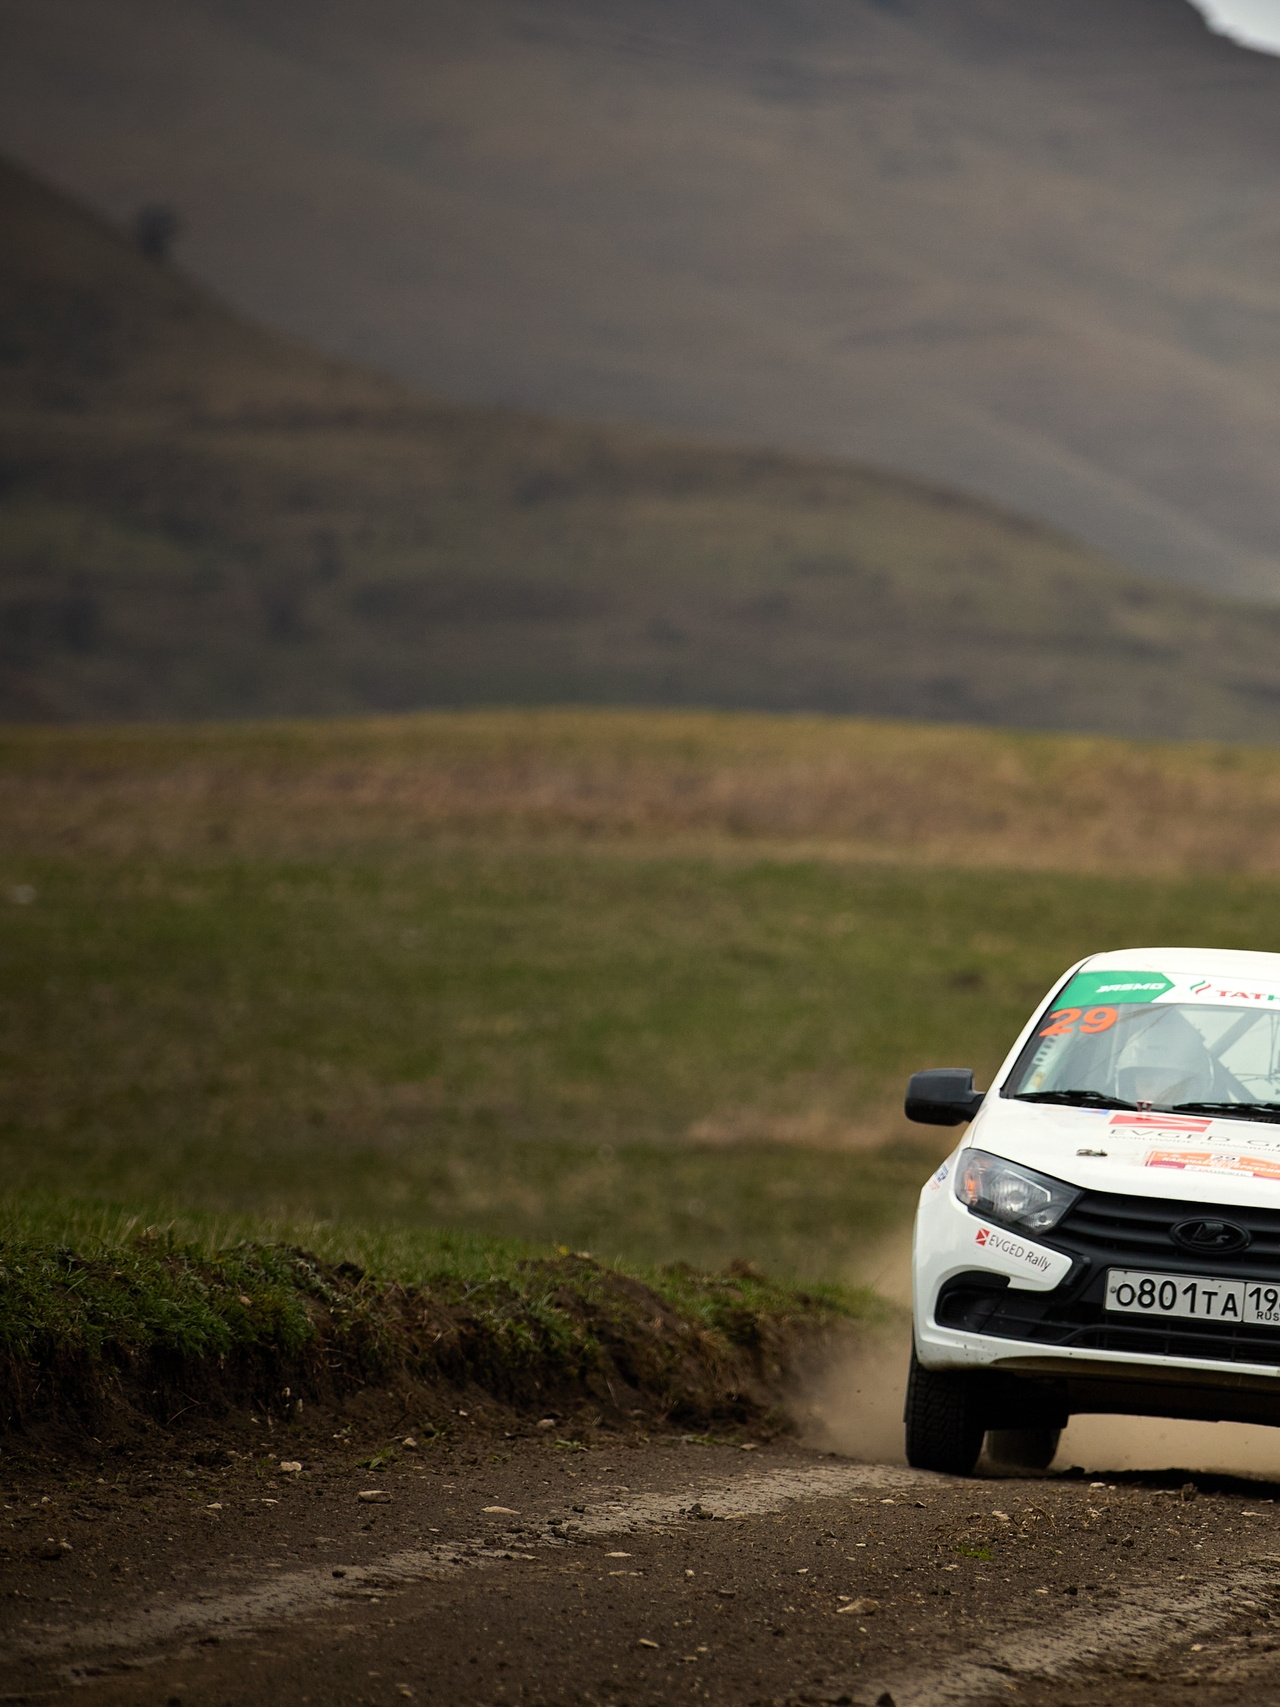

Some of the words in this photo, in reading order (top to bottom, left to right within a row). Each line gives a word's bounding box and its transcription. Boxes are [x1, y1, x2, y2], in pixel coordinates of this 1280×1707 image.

[1038, 1007, 1119, 1037] 29
[1110, 1129, 1230, 1142] EVGED
[988, 1234, 1025, 1258] EVGED
[1024, 1251, 1051, 1272] Rally
[1256, 1311, 1280, 1322] RUS
